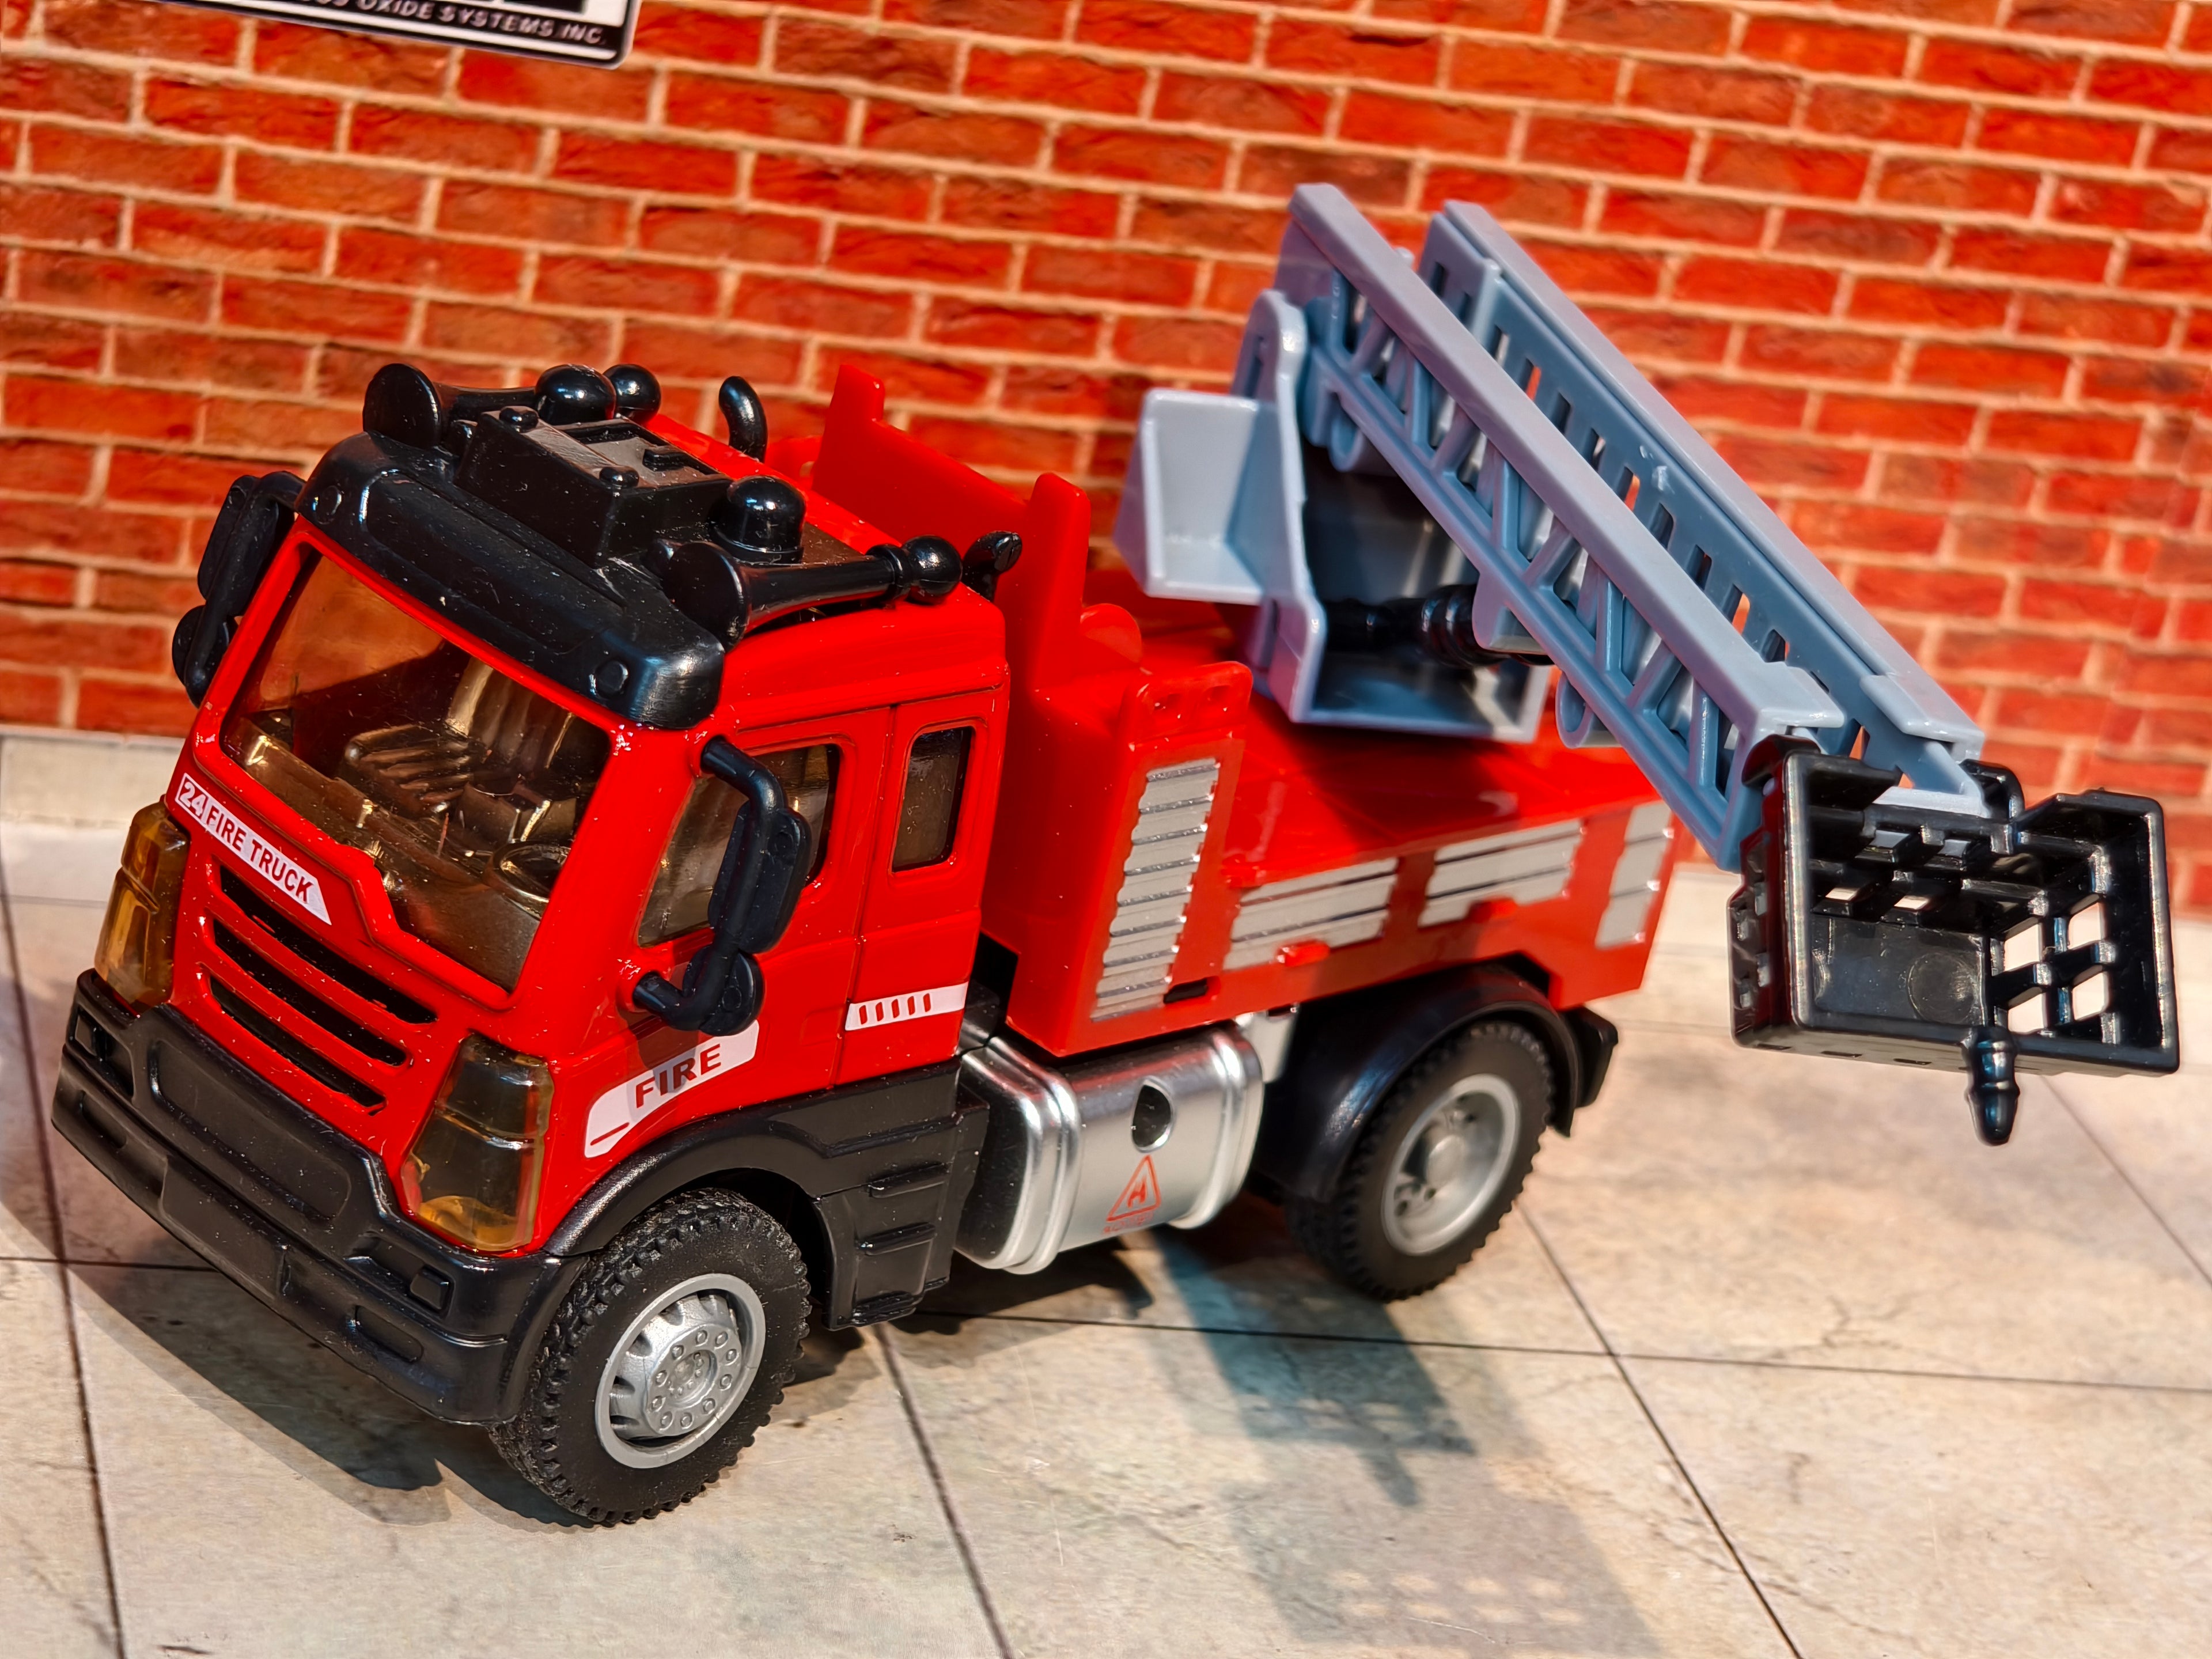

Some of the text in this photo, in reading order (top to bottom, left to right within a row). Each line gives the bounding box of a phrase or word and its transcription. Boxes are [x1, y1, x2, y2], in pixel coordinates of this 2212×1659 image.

[357, 0, 434, 20] OXIDE
[438, 5, 554, 37] SYSTEMS
[180, 782, 314, 904] 24 FIRE TRUCK
[635, 1043, 721, 1109] FIRE
